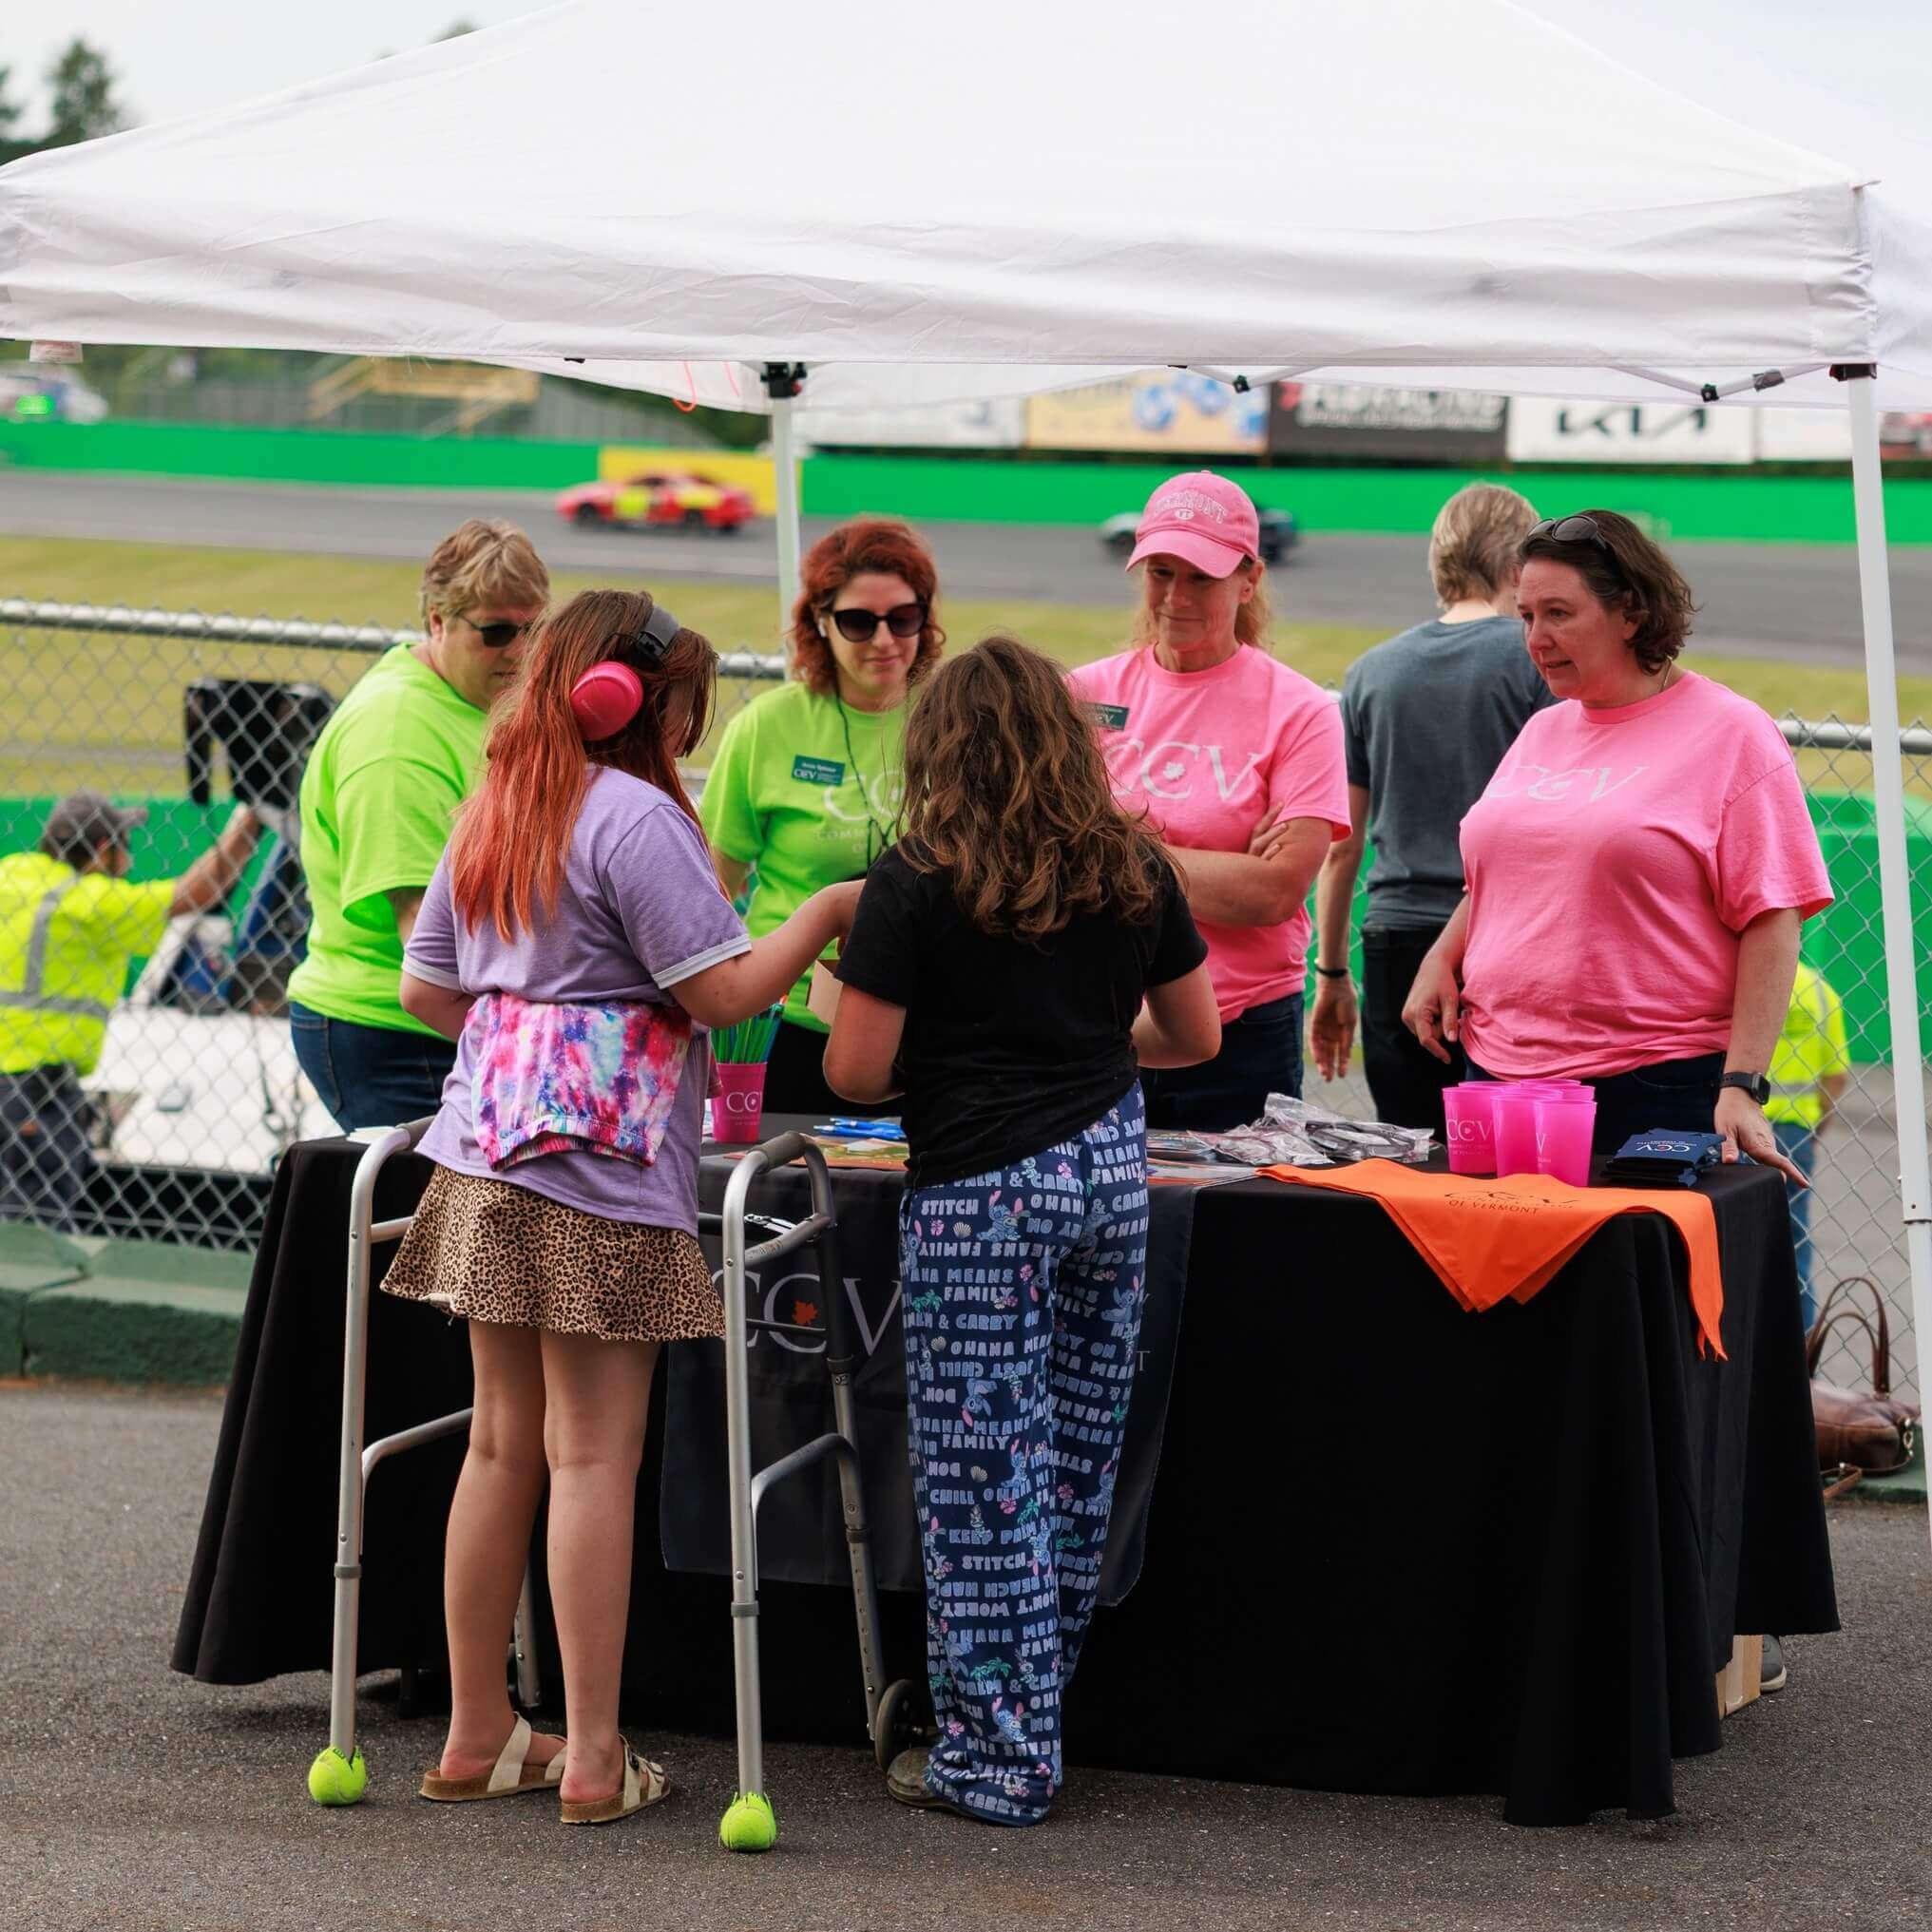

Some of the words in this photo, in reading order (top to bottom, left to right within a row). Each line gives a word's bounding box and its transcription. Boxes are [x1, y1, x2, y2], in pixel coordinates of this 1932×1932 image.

[822, 770, 906, 821] CC
[726, 1091, 760, 1113] CC
[1445, 1118, 1493, 1141] CCV
[921, 1198, 980, 1215] STITCH
[1104, 1216, 1148, 1239] OHAN
[947, 1267, 1014, 1283] MEANS
[945, 1286, 1015, 1302] FAMILY
[956, 1313, 1019, 1330] CARRY
[951, 1340, 1015, 1357] OHANA
[922, 1387, 956, 1404] DON'
[943, 1433, 1010, 1450] FAMILY
[928, 1461, 961, 1478] DON
[929, 1488, 975, 1505] CHILL
[962, 1552, 1026, 1571] STITCH
